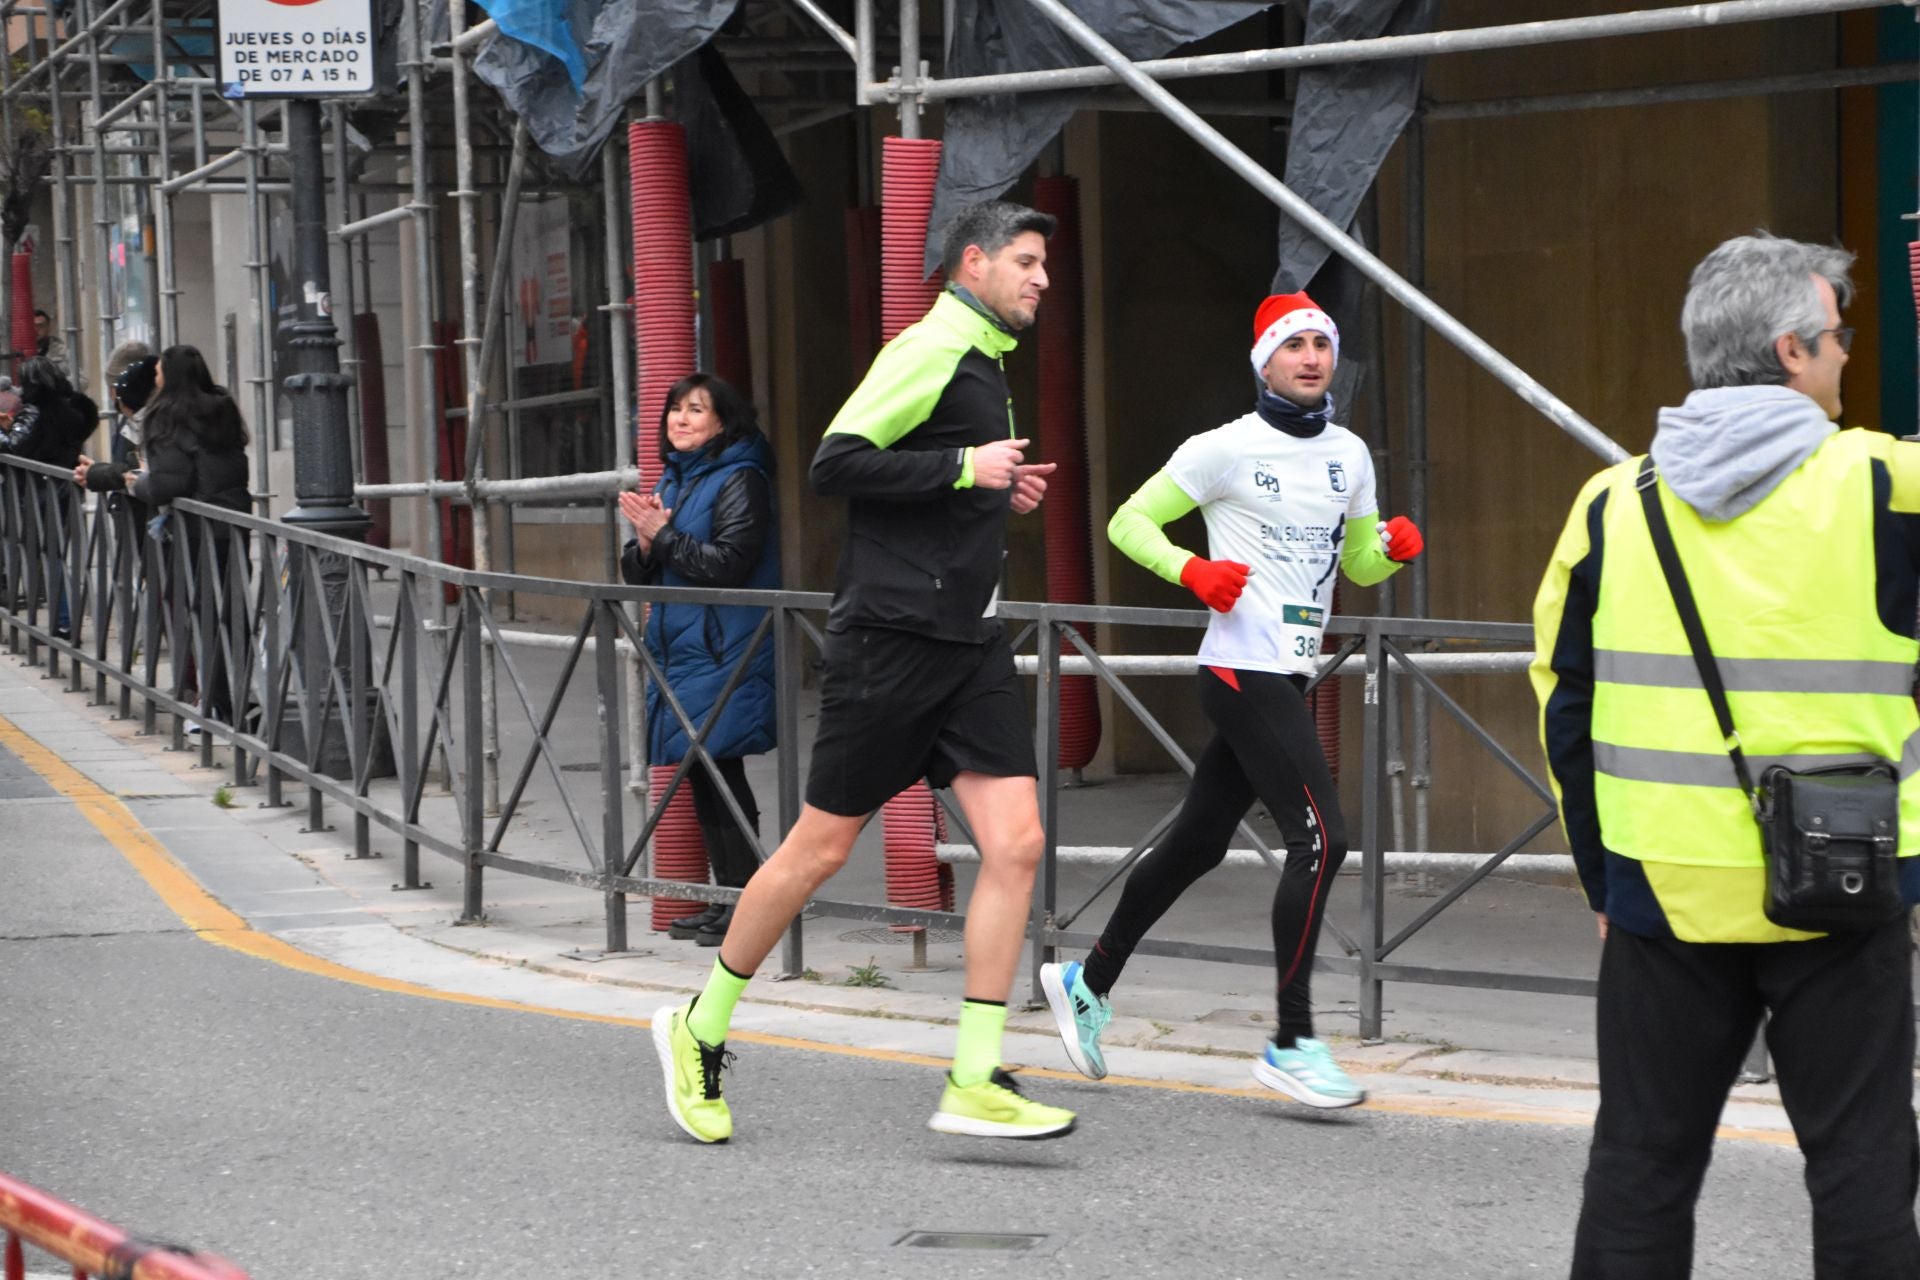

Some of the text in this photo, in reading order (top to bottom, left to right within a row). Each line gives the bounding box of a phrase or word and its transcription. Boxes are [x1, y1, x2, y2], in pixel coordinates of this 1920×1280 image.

[226, 27, 366, 45] JUEVES O DÍAS
[235, 50, 359, 63] DE MERCADO
[239, 68, 357, 82] DE 07 A 15 h
